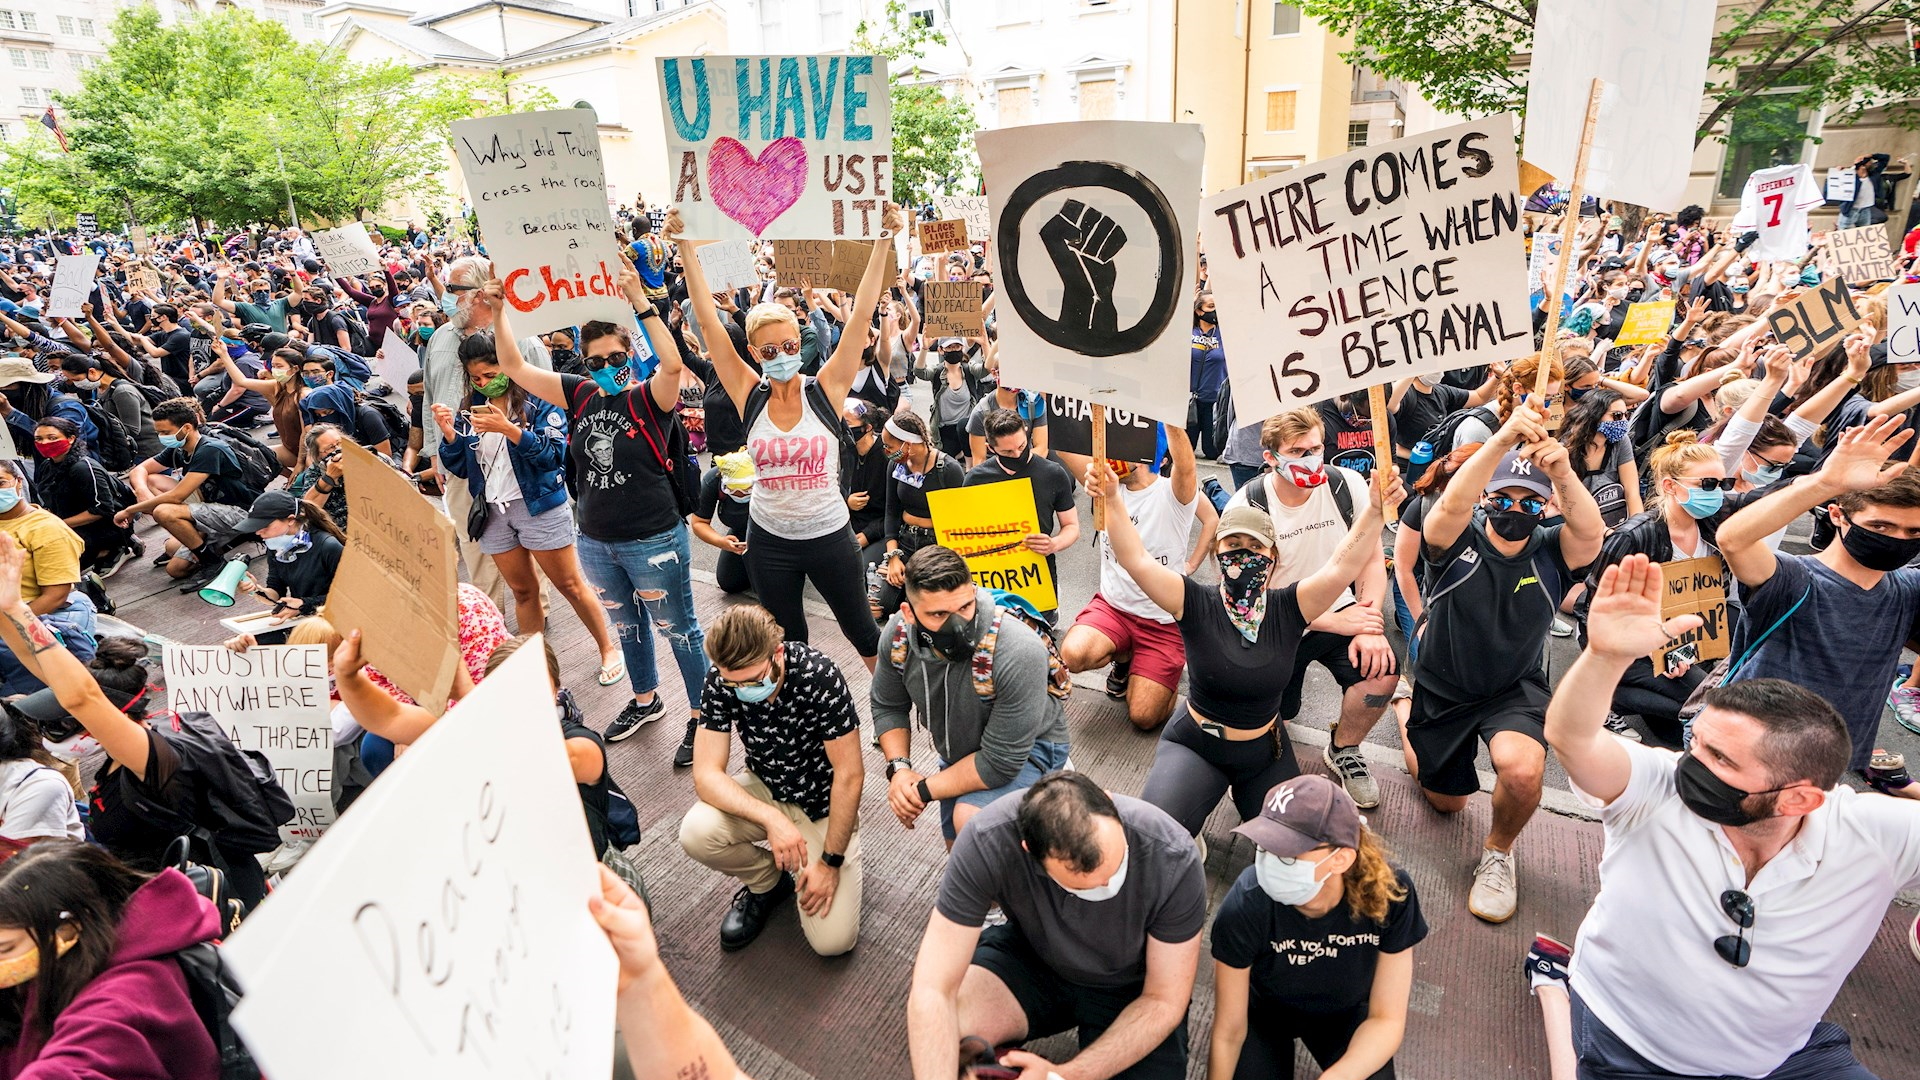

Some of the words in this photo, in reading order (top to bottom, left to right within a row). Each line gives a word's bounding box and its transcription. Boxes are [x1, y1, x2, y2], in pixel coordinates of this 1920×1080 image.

[663, 57, 711, 142] U
[735, 57, 873, 141] HAVE
[462, 132, 527, 169] Why
[534, 139, 555, 157] did
[675, 151, 702, 202] A
[823, 154, 888, 197] USE
[482, 183, 531, 201] cross
[541, 177, 566, 188] the
[1214, 173, 1336, 260] THERE
[1344, 132, 1495, 216] COMES
[941, 196, 989, 212] BLACK
[1763, 193, 1783, 228] 7
[523, 221, 579, 236] Because
[924, 222, 955, 235] BLACK
[929, 231, 955, 241] LIVES
[1831, 224, 1889, 248] BLACK
[319, 233, 345, 245] BLACK
[568, 239, 579, 249] a
[778, 240, 823, 255] BLACK
[925, 235, 965, 251] MATTER!
[324, 242, 358, 257] LIVES
[703, 242, 743, 265] BLACK
[838, 248, 865, 263] BLA
[1260, 261, 1281, 313] A
[1306, 215, 1408, 284] TIME
[1420, 191, 1519, 251] WHEN
[1835, 243, 1890, 265] LIVES
[329, 257, 373, 274] MATTER
[715, 260, 748, 276] LIVES
[784, 257, 821, 270] LIVES
[1836, 260, 1896, 282] MATTER
[926, 284, 941, 299] NO
[944, 282, 981, 299] JUSTICE
[1288, 256, 1459, 337] SILENCE
[926, 300, 941, 313] NO
[944, 300, 976, 313] PEACE
[927, 315, 948, 325] BLACK
[940, 322, 964, 331] LIVES
[1768, 275, 1861, 362] BLM
[954, 328, 981, 337] MATTER
[1269, 351, 1321, 403] IS
[1341, 300, 1528, 379] BETRAYAL
[752, 435, 828, 464] 2020
[758, 476, 829, 491] MATTERS
[1599, 488, 1618, 502] TEAM
[942, 520, 1032, 542] THOUGHTS
[1279, 527, 1303, 542] SHOOT
[1304, 519, 1336, 532] RACISTS
[1669, 576, 1689, 595] NOT
[170, 648, 324, 679] INJUSTICE
[175, 686, 317, 712] ANYWHERE
[231, 725, 241, 749] A
[253, 726, 333, 749] THREAT
[275, 768, 332, 794] TICE
[1328, 934, 1355, 947] FOR
[1356, 933, 1380, 946] THE
